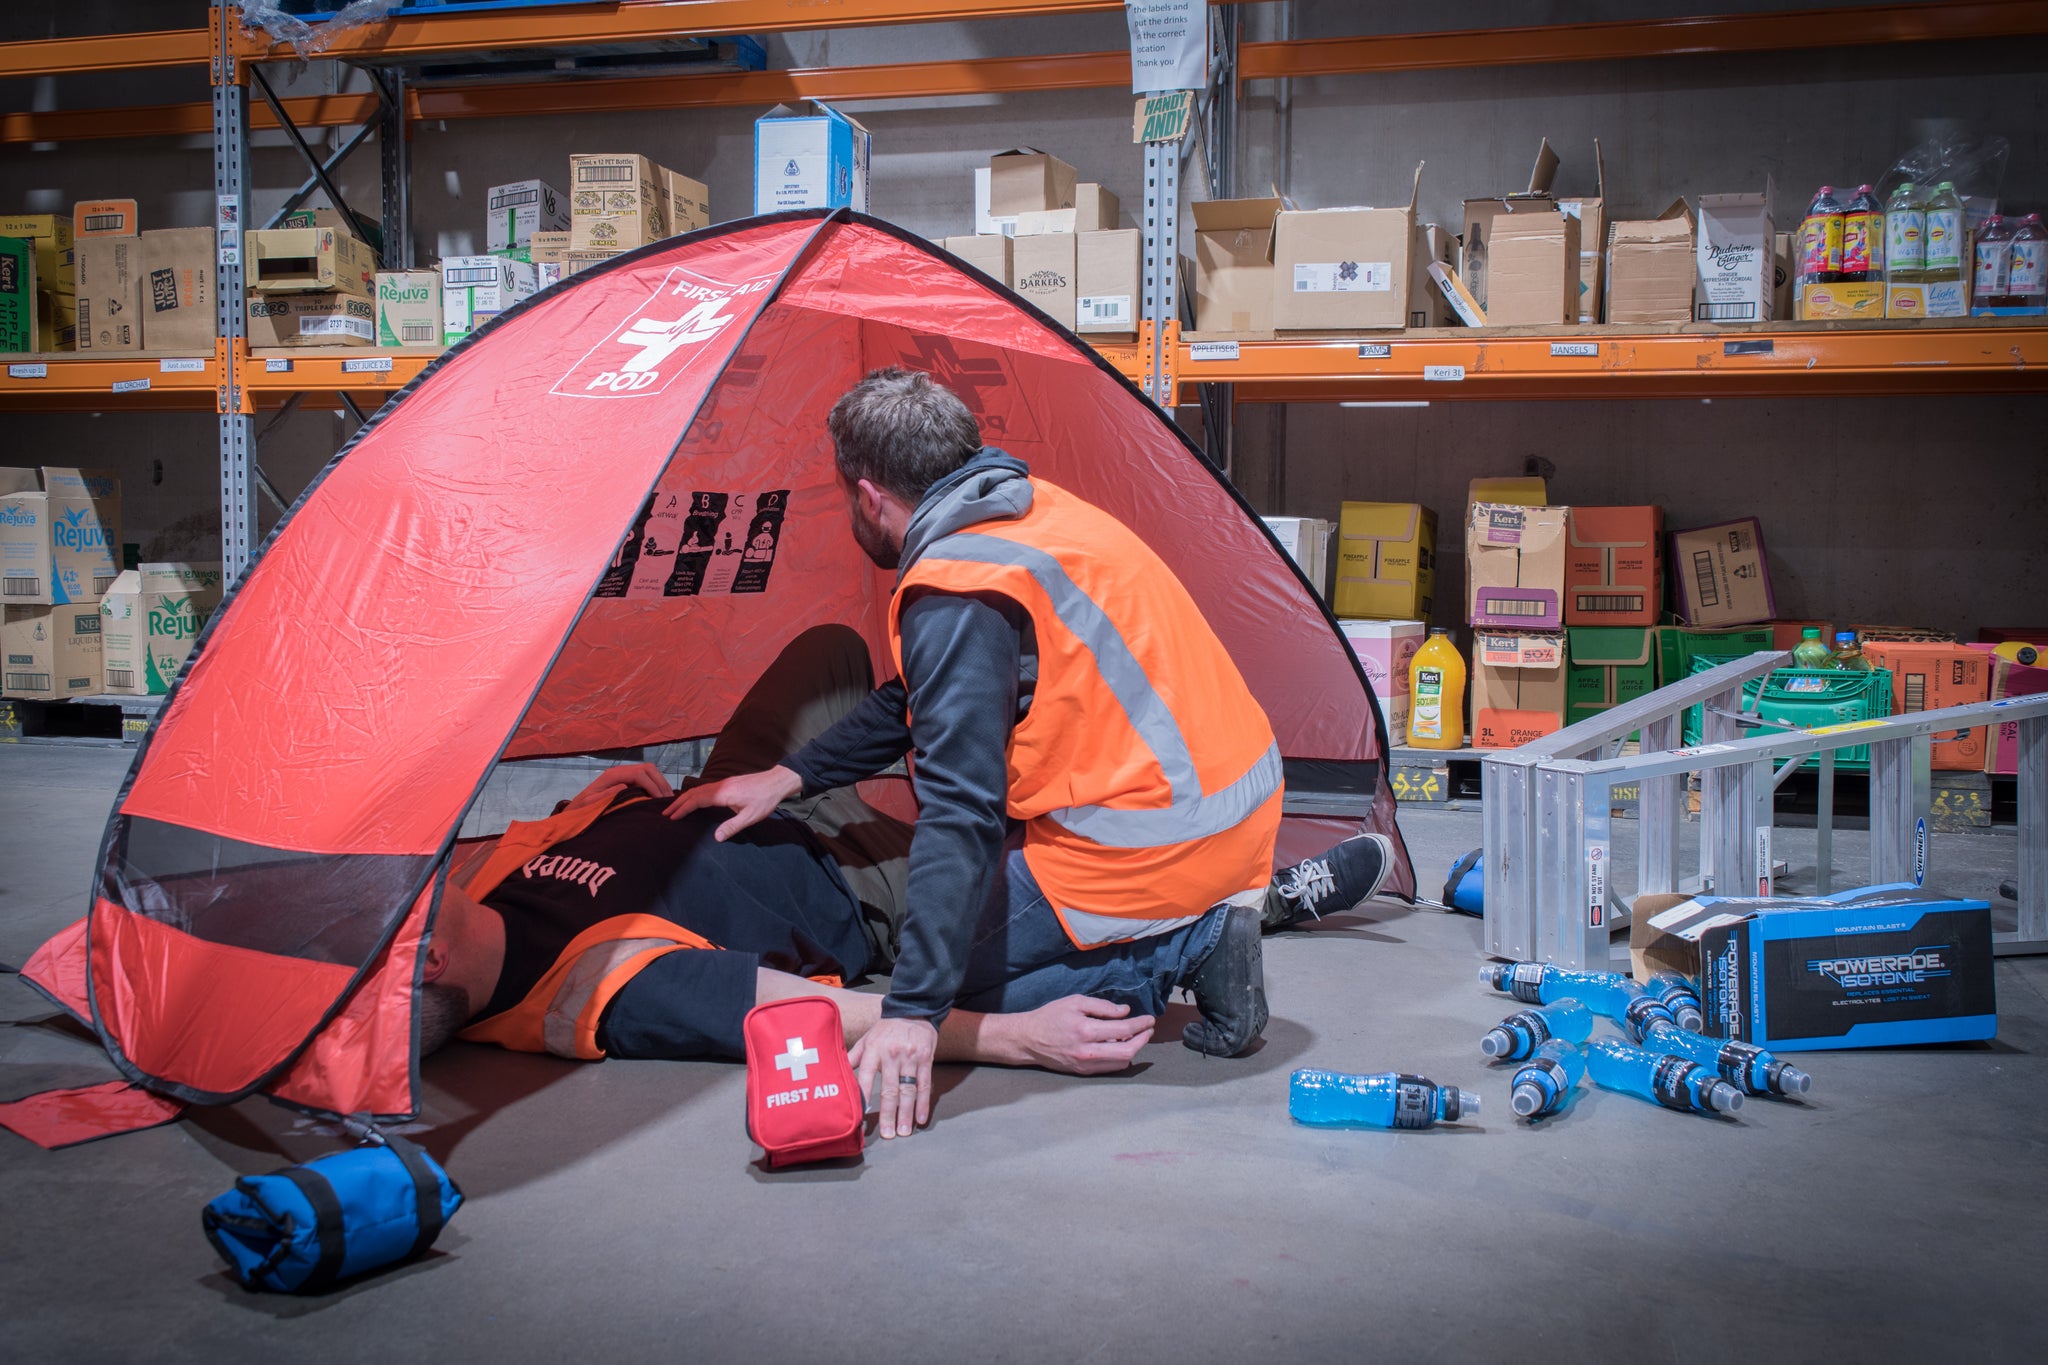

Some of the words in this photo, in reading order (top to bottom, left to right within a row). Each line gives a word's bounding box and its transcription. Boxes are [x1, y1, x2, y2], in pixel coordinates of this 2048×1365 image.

[1134, 5, 1146, 14] the
[1149, 4, 1171, 13] labels
[1134, 19, 1147, 27] put
[1149, 17, 1161, 25] the
[1164, 16, 1188, 25] drinks
[1143, 31, 1156, 39] the
[1158, 30, 1186, 38] correct
[1136, 45, 1166, 53] location
[1137, 58, 1158, 67] Thank
[1160, 59, 1174, 67] you
[1144, 92, 1187, 116] HANDY
[1141, 108, 1187, 142] ANDY
[544, 187, 557, 216] V8
[288, 217, 308, 229] JUST
[1704, 243, 1755, 260] Buderim
[1717, 253, 1753, 271] Ginger
[503, 264, 515, 290] V8
[1020, 274, 1067, 290] BARKER'S
[152, 273, 167, 309] JUST
[162, 267, 177, 308] JUICE
[184, 269, 193, 307] ORANGE
[732, 279, 772, 297] AID
[1929, 287, 1956, 300] Light
[379, 285, 429, 304] Rejuva
[251, 302, 289, 317] RARO
[319, 303, 342, 311] PACKS
[347, 301, 371, 317] RARO
[9, 299, 18, 352] APPLE
[330, 320, 343, 328] 2737
[1191, 345, 1235, 353] APPLETISER
[1365, 345, 1388, 355] PAMS
[1551, 345, 1589, 355] HANSELS
[167, 361, 178, 369] Just
[346, 360, 360, 370] JUST
[361, 360, 378, 369] JUICE
[1433, 368, 1451, 377] Keri
[1453, 368, 1462, 377] 3L
[585, 371, 660, 392] POD
[666, 495, 677, 509] A
[702, 494, 710, 509] B
[734, 494, 745, 507] C
[0, 512, 36, 527] Rejuva
[692, 509, 719, 518] Breathing
[1493, 512, 1520, 525] Keri
[54, 521, 115, 553] Rejuva
[1343, 553, 1369, 561] PINEAPPLE
[1384, 557, 1410, 565] PINEAPPLE
[69, 636, 93, 646] LIQUID
[1490, 638, 1516, 648] Keri
[1523, 649, 1553, 659] 50%
[159, 657, 179, 671] 41%
[1421, 672, 1438, 681] Keri
[1953, 662, 1963, 684] VISY
[1481, 727, 1495, 737] 3L
[1510, 729, 1543, 737] ORANGE
[2006, 721, 2018, 741] CAL
[1598, 886, 1602, 895] OR
[1592, 895, 1597, 904] DO
[1840, 970, 1925, 988] ISOTONIC
[1718, 956, 1729, 1024] ISOTONIC
[1728, 940, 1740, 1035] POWERADE
[1832, 998, 1881, 1006] ELECTROLYTES
[766, 1089, 809, 1109] FIRST
[814, 1083, 839, 1098] AID
